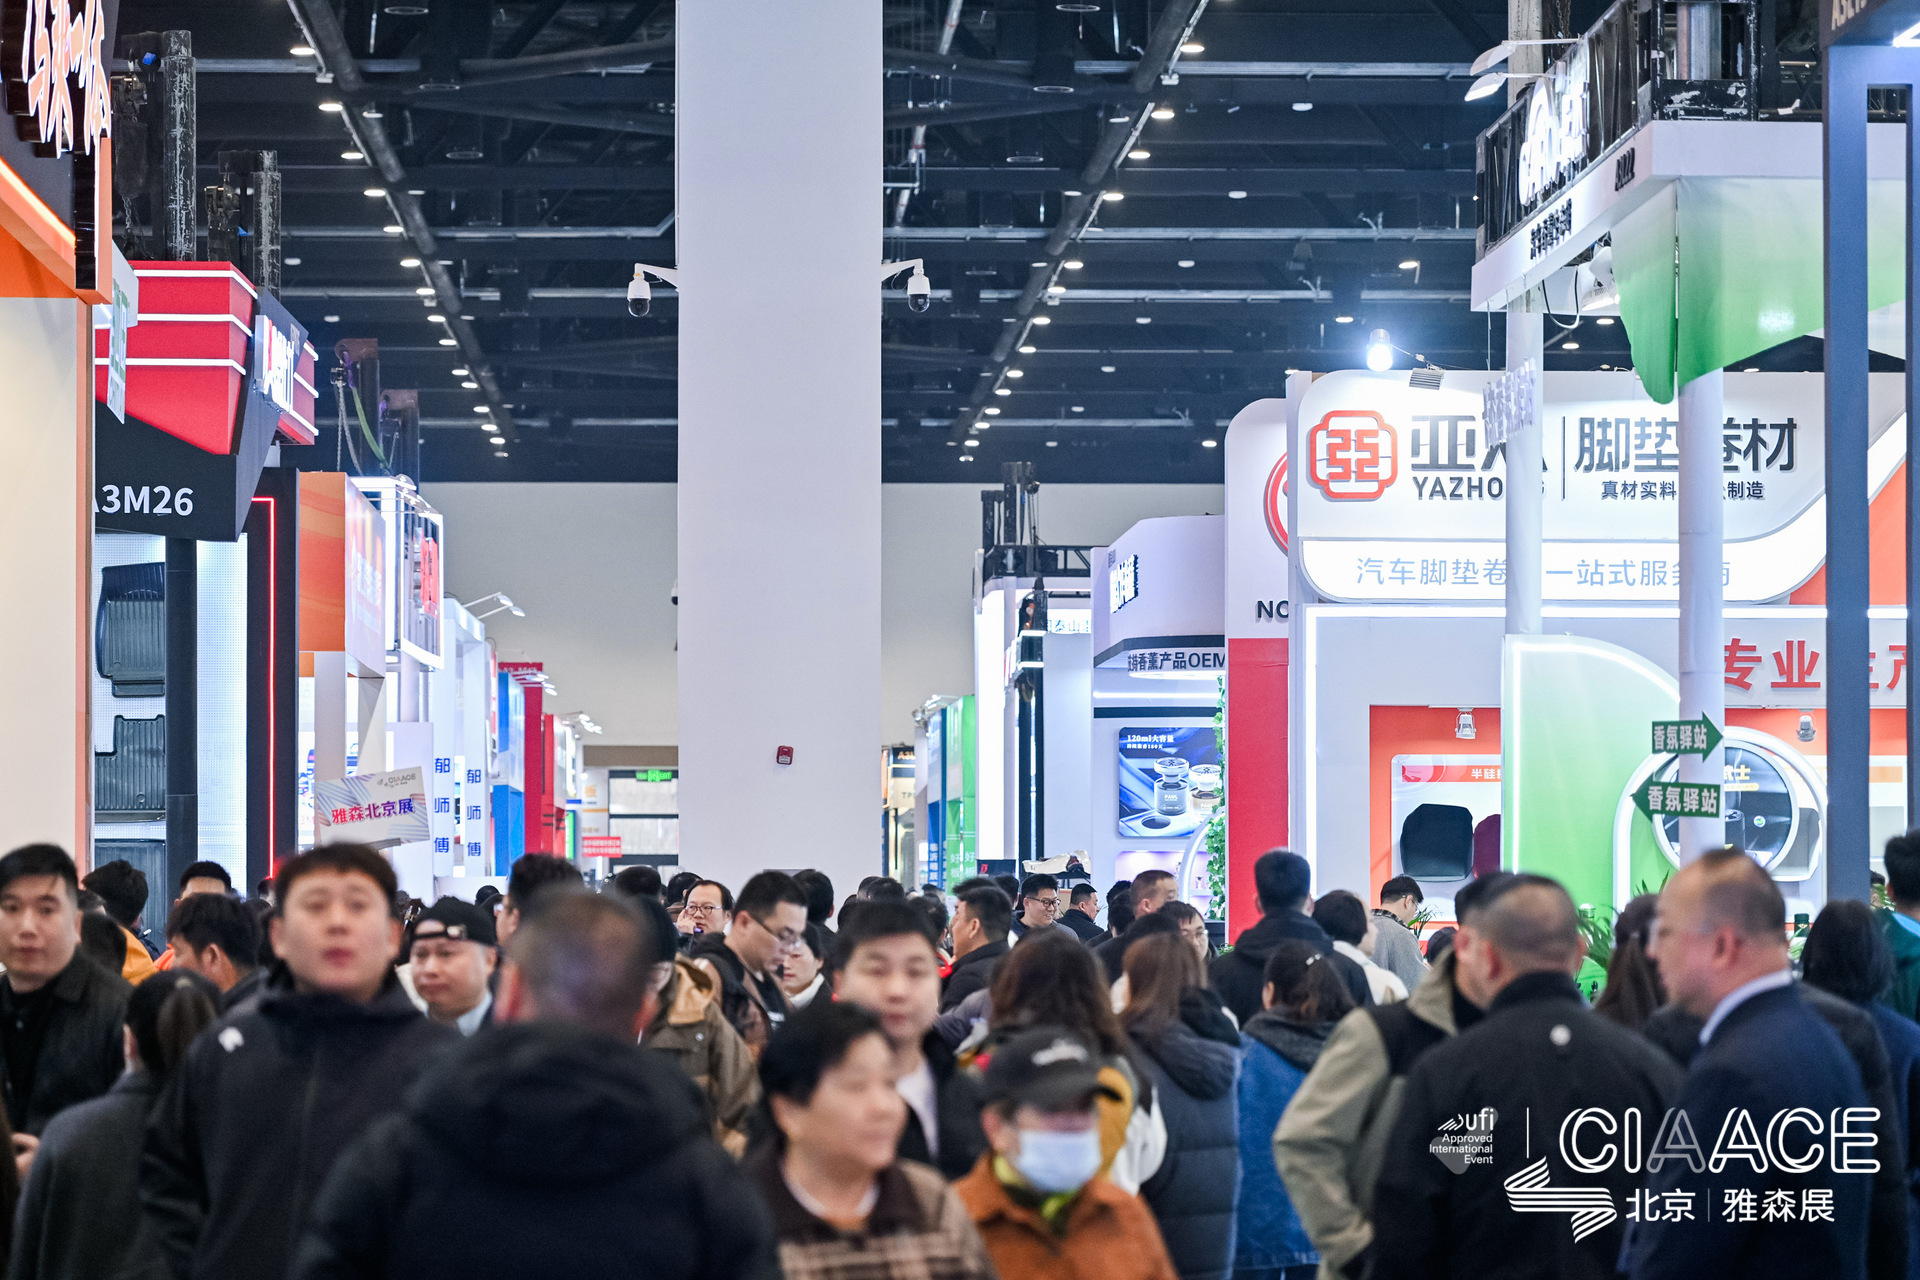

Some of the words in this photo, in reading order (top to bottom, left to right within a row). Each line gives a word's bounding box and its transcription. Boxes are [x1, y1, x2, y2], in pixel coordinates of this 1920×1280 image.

[1411, 415, 1548, 471] 亚
[1412, 477, 1546, 499] YAZHO
[1601, 480, 1678, 499] 真材实料
[1356, 557, 1730, 587] 汽车脚垫卷一站式服
[1725, 638, 1907, 691] 专业
[1653, 724, 1708, 750] 香氛驿站
[331, 797, 415, 825] 雅森北京展
[1647, 785, 1718, 814] 香氛驿站
